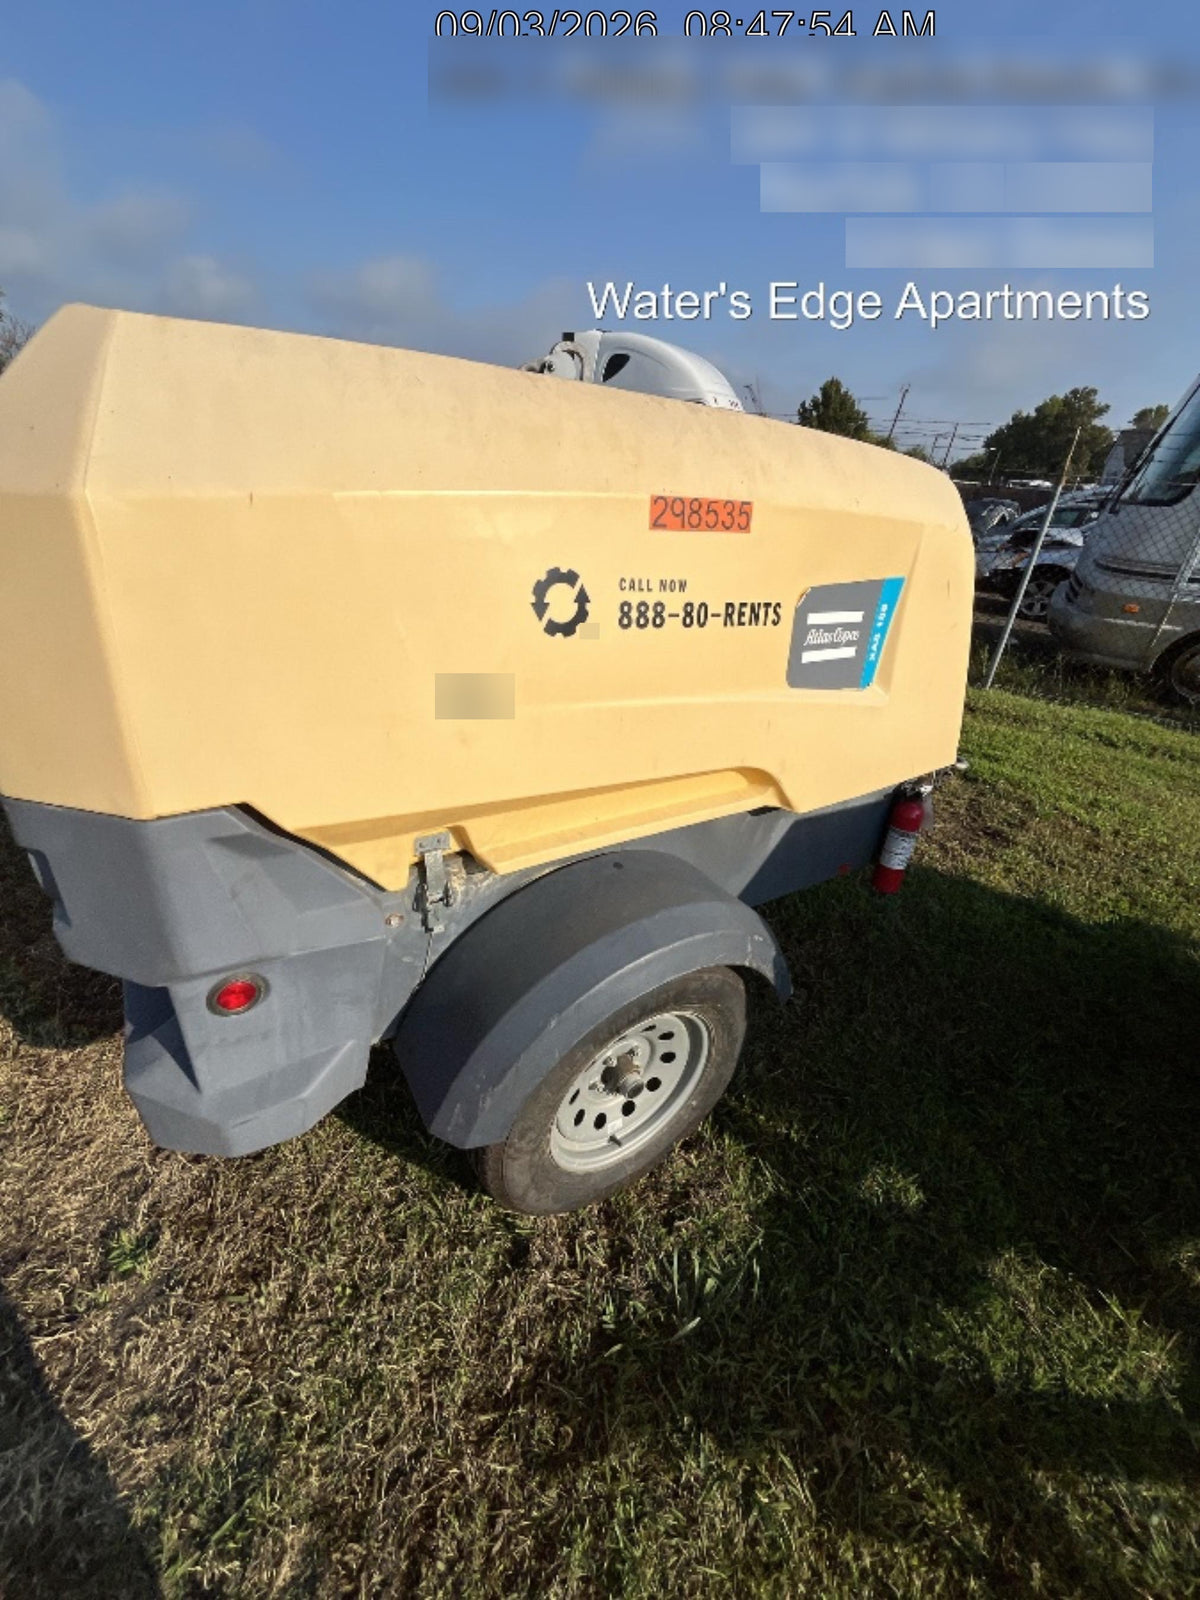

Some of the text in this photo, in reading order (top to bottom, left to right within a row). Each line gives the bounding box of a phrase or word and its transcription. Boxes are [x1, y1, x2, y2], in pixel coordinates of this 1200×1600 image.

[652, 496, 752, 531] 298535
[618, 577, 687, 593] CALL NOW
[618, 600, 782, 630] 888-80-RENTS
